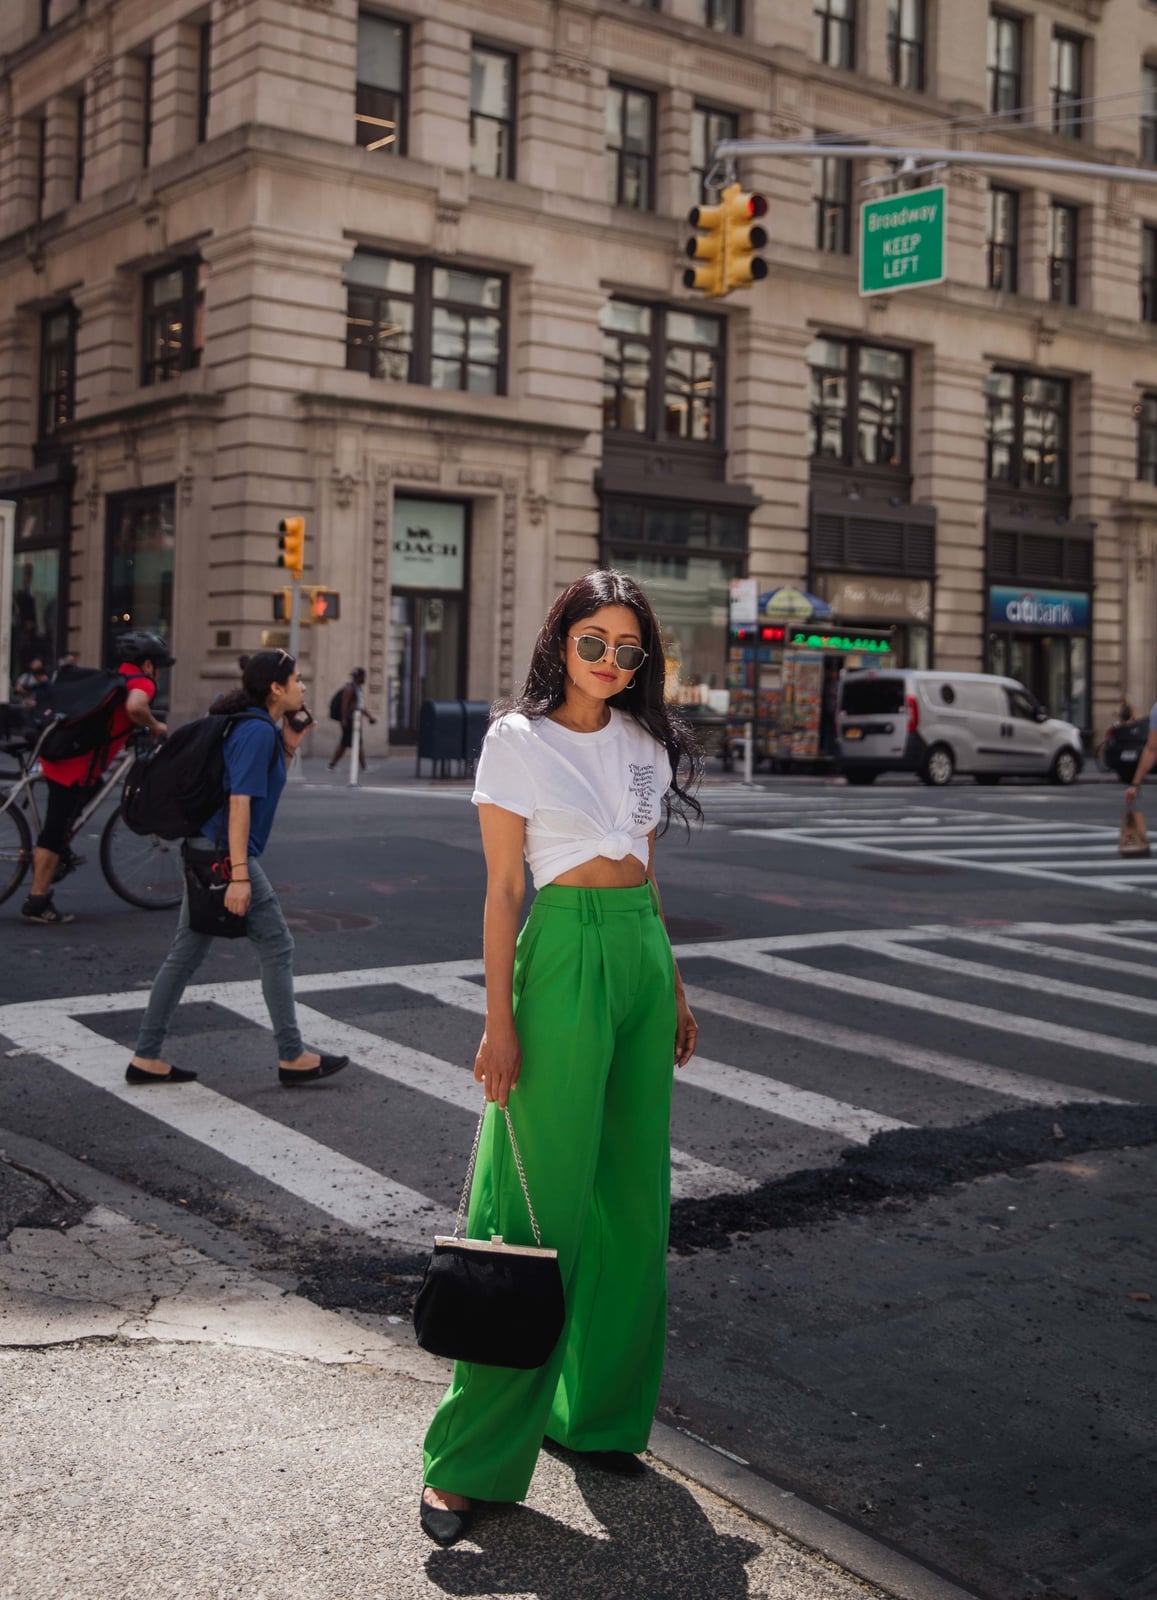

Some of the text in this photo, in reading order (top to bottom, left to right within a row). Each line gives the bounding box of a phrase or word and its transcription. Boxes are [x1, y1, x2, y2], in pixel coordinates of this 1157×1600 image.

[869, 204, 938, 232] Broadway
[883, 233, 921, 256] KEEP
[883, 255, 919, 279] LEFT
[393, 541, 457, 557] OACH
[1006, 596, 1073, 625] citibank
